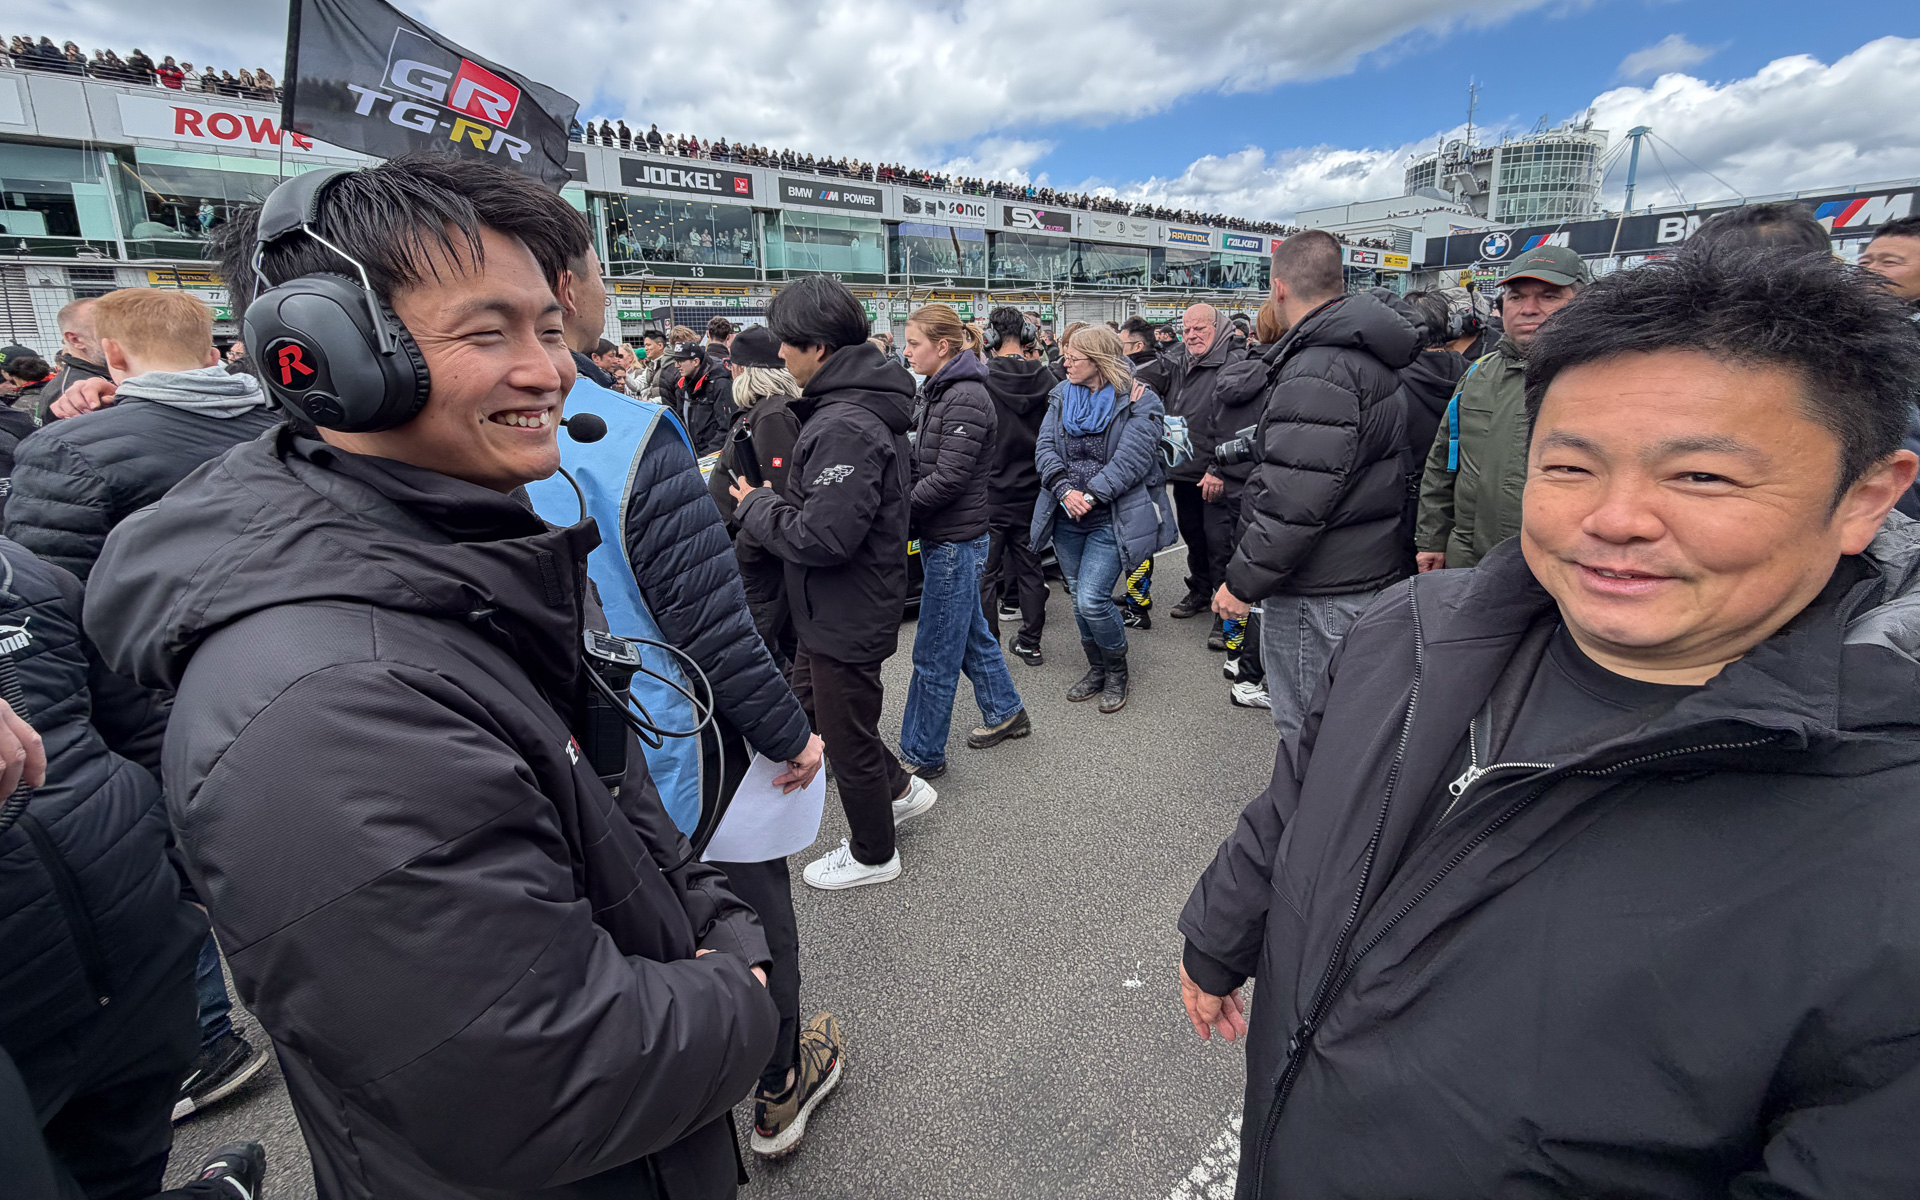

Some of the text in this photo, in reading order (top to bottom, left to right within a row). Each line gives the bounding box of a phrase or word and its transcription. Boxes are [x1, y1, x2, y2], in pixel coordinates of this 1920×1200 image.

[391, 59, 511, 123] GR
[347, 83, 532, 164] TG-RR
[788, 186, 812, 199] BMW
[843, 193, 875, 206] POWER
[1171, 231, 1208, 243] RAVENOL
[1226, 237, 1259, 249] FALKEN
[690, 266, 704, 277] 13
[832, 273, 842, 281] 12
